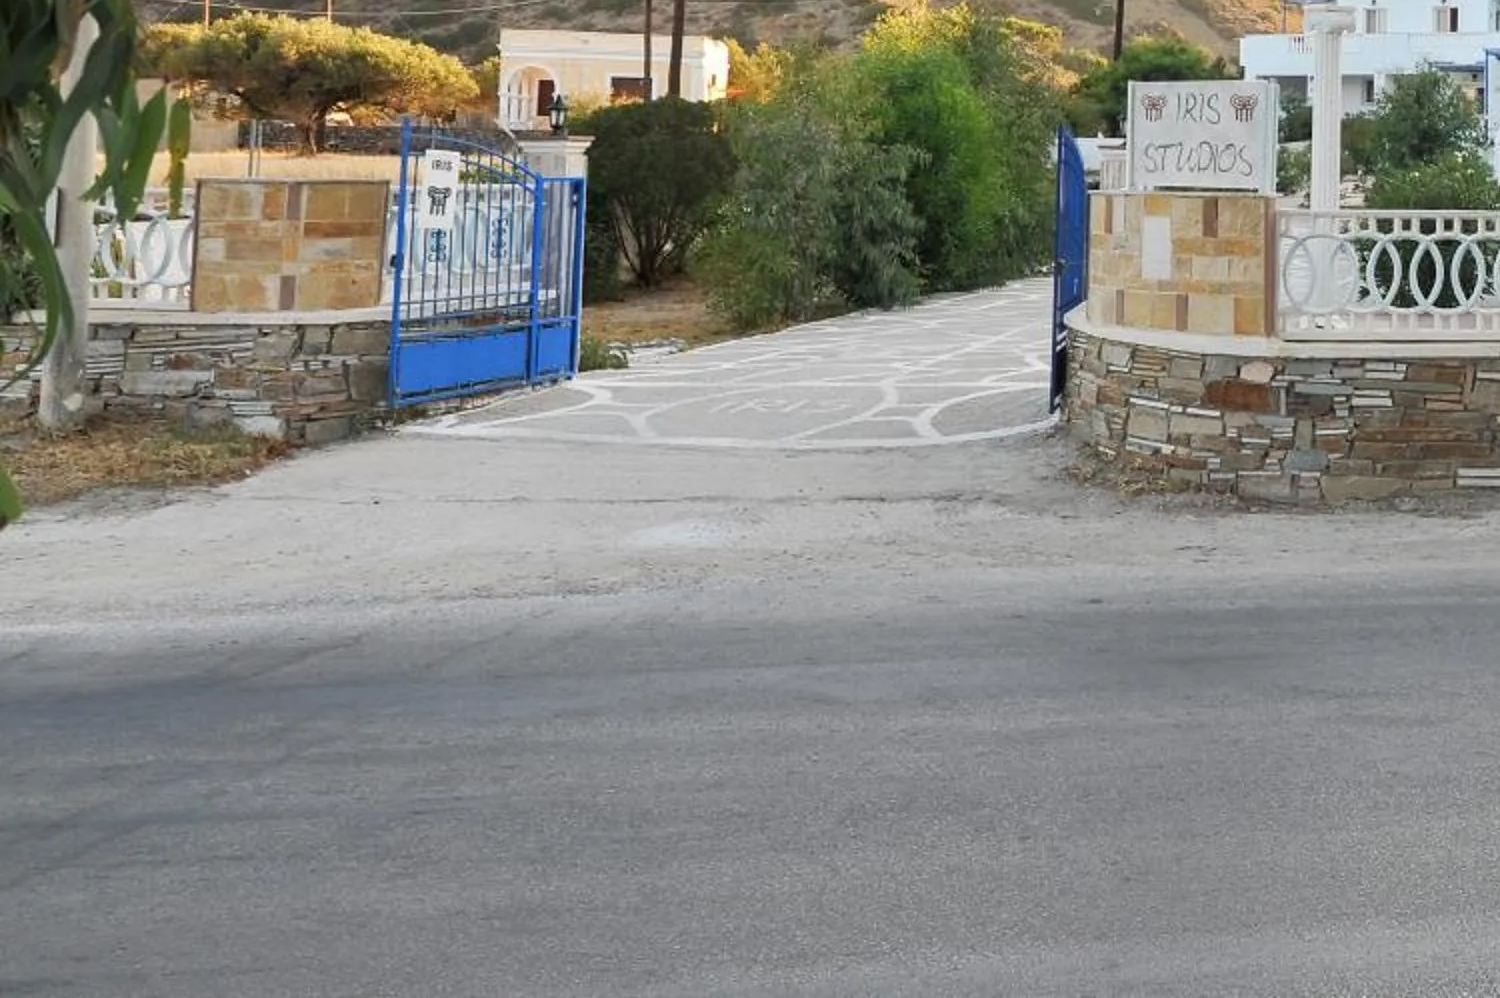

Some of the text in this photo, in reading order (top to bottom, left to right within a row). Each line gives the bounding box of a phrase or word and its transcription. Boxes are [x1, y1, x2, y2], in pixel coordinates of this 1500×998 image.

[1175, 92, 1221, 124] IRIS
[431, 159, 453, 172] IRIS
[1143, 141, 1253, 177] STUDIOS
